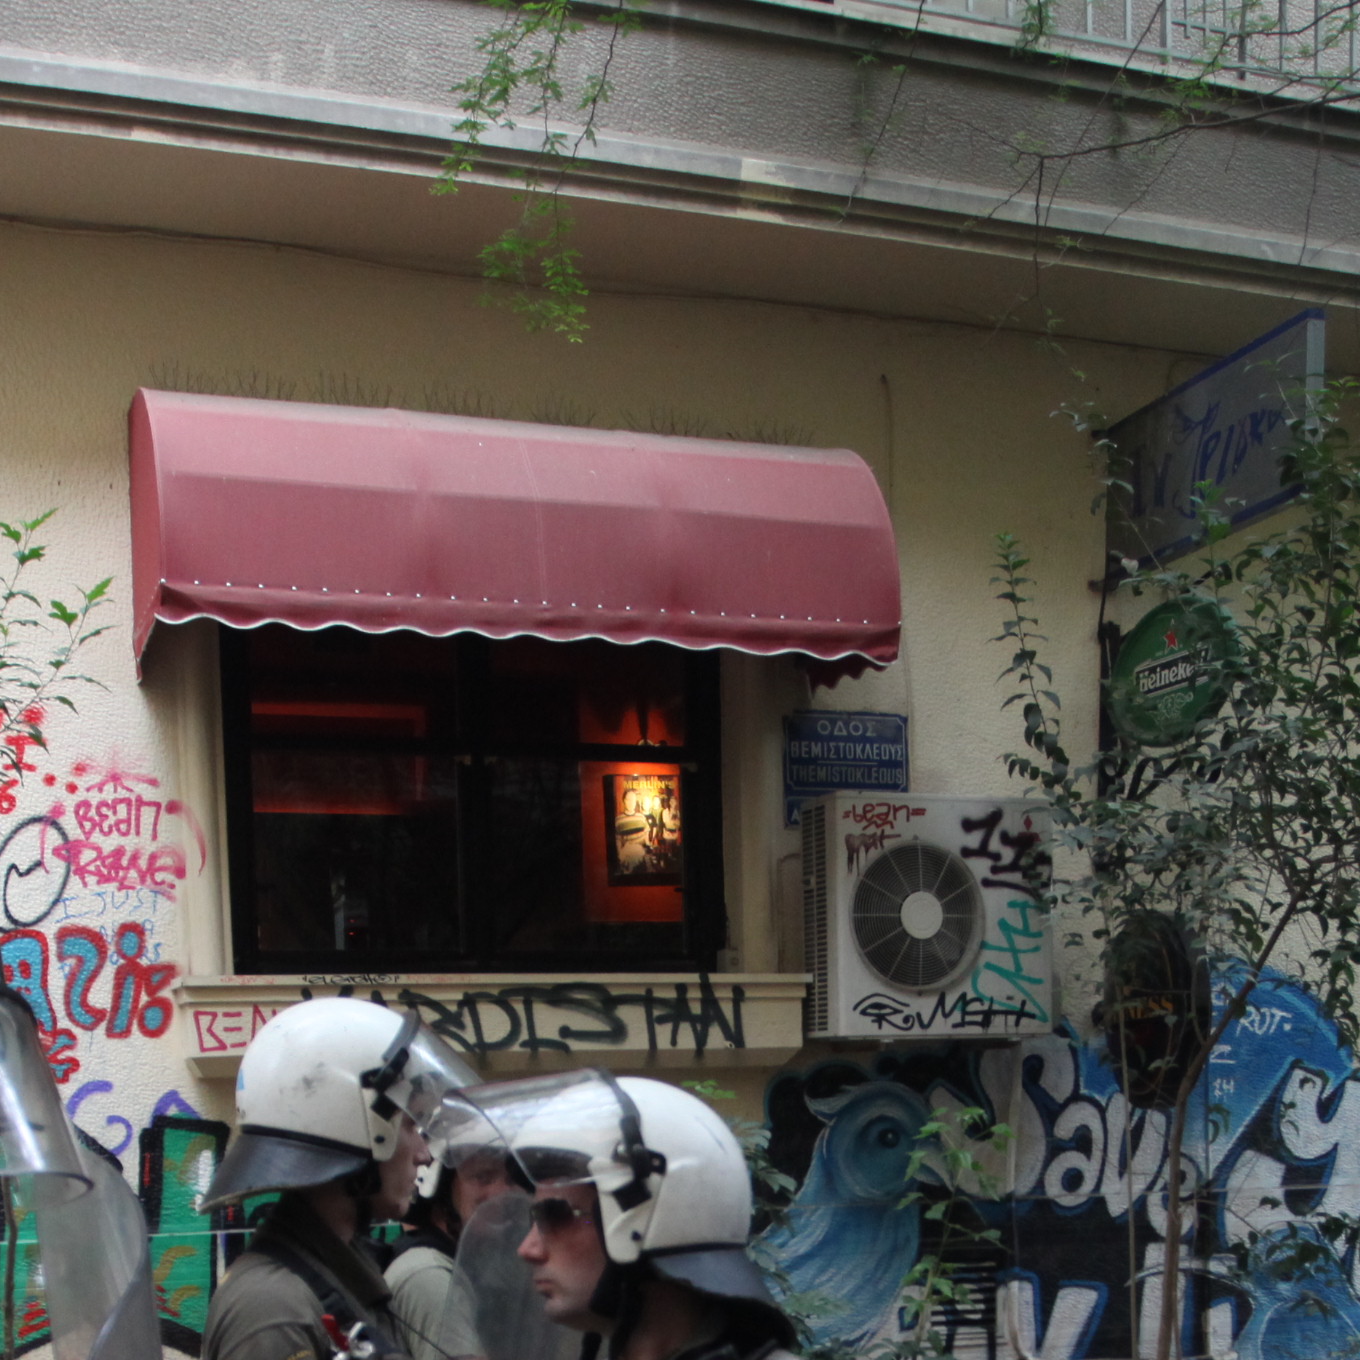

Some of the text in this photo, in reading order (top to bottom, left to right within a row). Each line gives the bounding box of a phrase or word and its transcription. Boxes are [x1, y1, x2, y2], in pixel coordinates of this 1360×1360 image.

[1138, 661, 1197, 693] Heineke
[817, 719, 877, 737] ΟΔΟΣ
[790, 740, 905, 761] ΘΕΜΙΣΤΟΚΛΕΟΥΣ
[790, 766, 904, 786] THEMISTOKLEOUS
